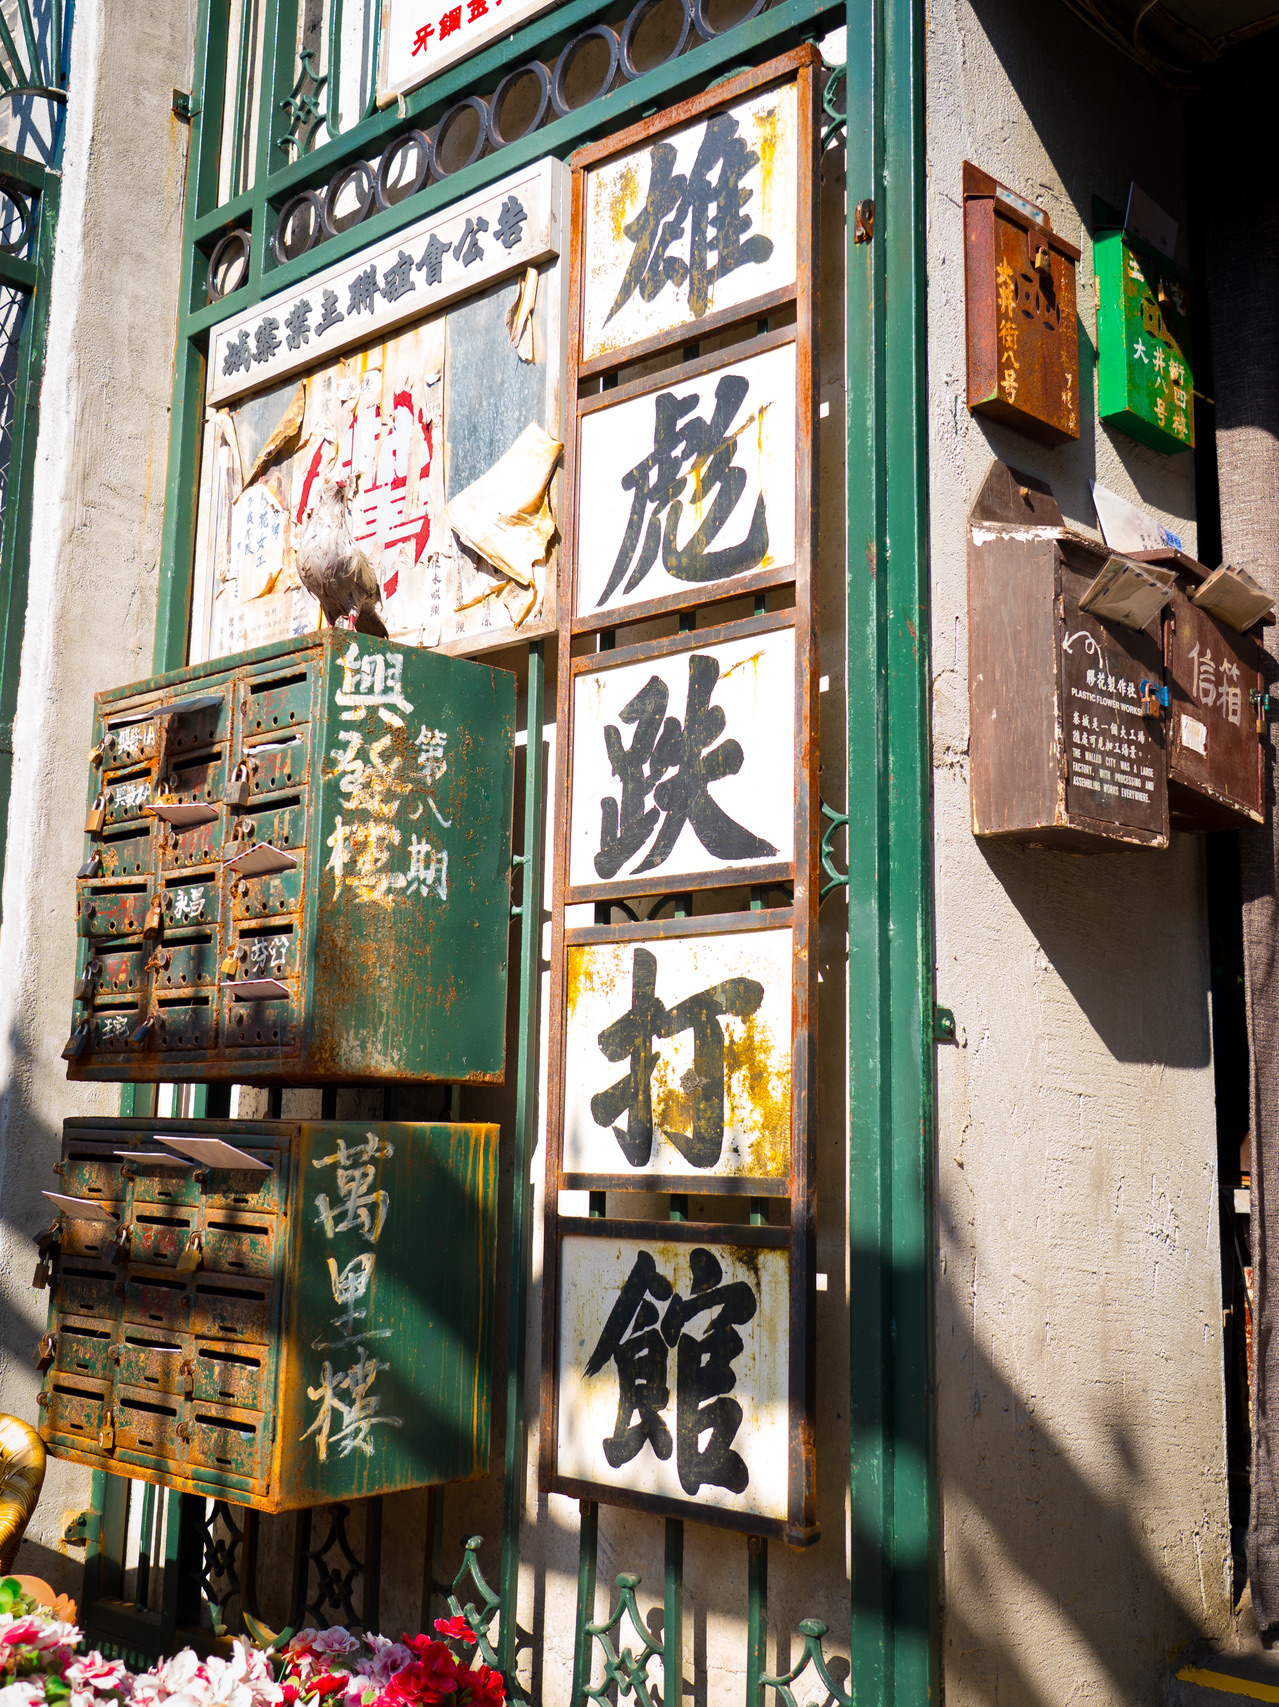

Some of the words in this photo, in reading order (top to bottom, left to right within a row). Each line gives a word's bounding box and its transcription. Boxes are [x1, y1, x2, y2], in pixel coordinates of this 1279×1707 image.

[222, 195, 528, 376] 城寨業主聯誼會公告
[1086, 668, 1137, 699] 膠花製作社
[1187, 640, 1242, 728] 信箱
[1071, 687, 1096, 703] PLASTIC
[1096, 695, 1120, 710] FLOWER
[1120, 702, 1143, 717] WORKS
[1072, 747, 1081, 759] THE
[1085, 751, 1102, 764] WALLED
[1105, 756, 1117, 768] CITY
[1120, 760, 1130, 772] WAS
[1133, 764, 1137, 774] A
[1140, 766, 1154, 778] LARGE
[1072, 761, 1095, 776] FACTORY,
[1099, 768, 1111, 780] WITH
[1114, 772, 1141, 788] PROCESSING
[1145, 780, 1154, 791] AND
[1072, 775, 1101, 791] ASSEMBLING
[1103, 783, 1119, 796] WORKS
[1121, 787, 1151, 803] EVERYWHERE.
[406, 724, 452, 901] 第八期
[300, 1131, 405, 1463] 萬里樓
